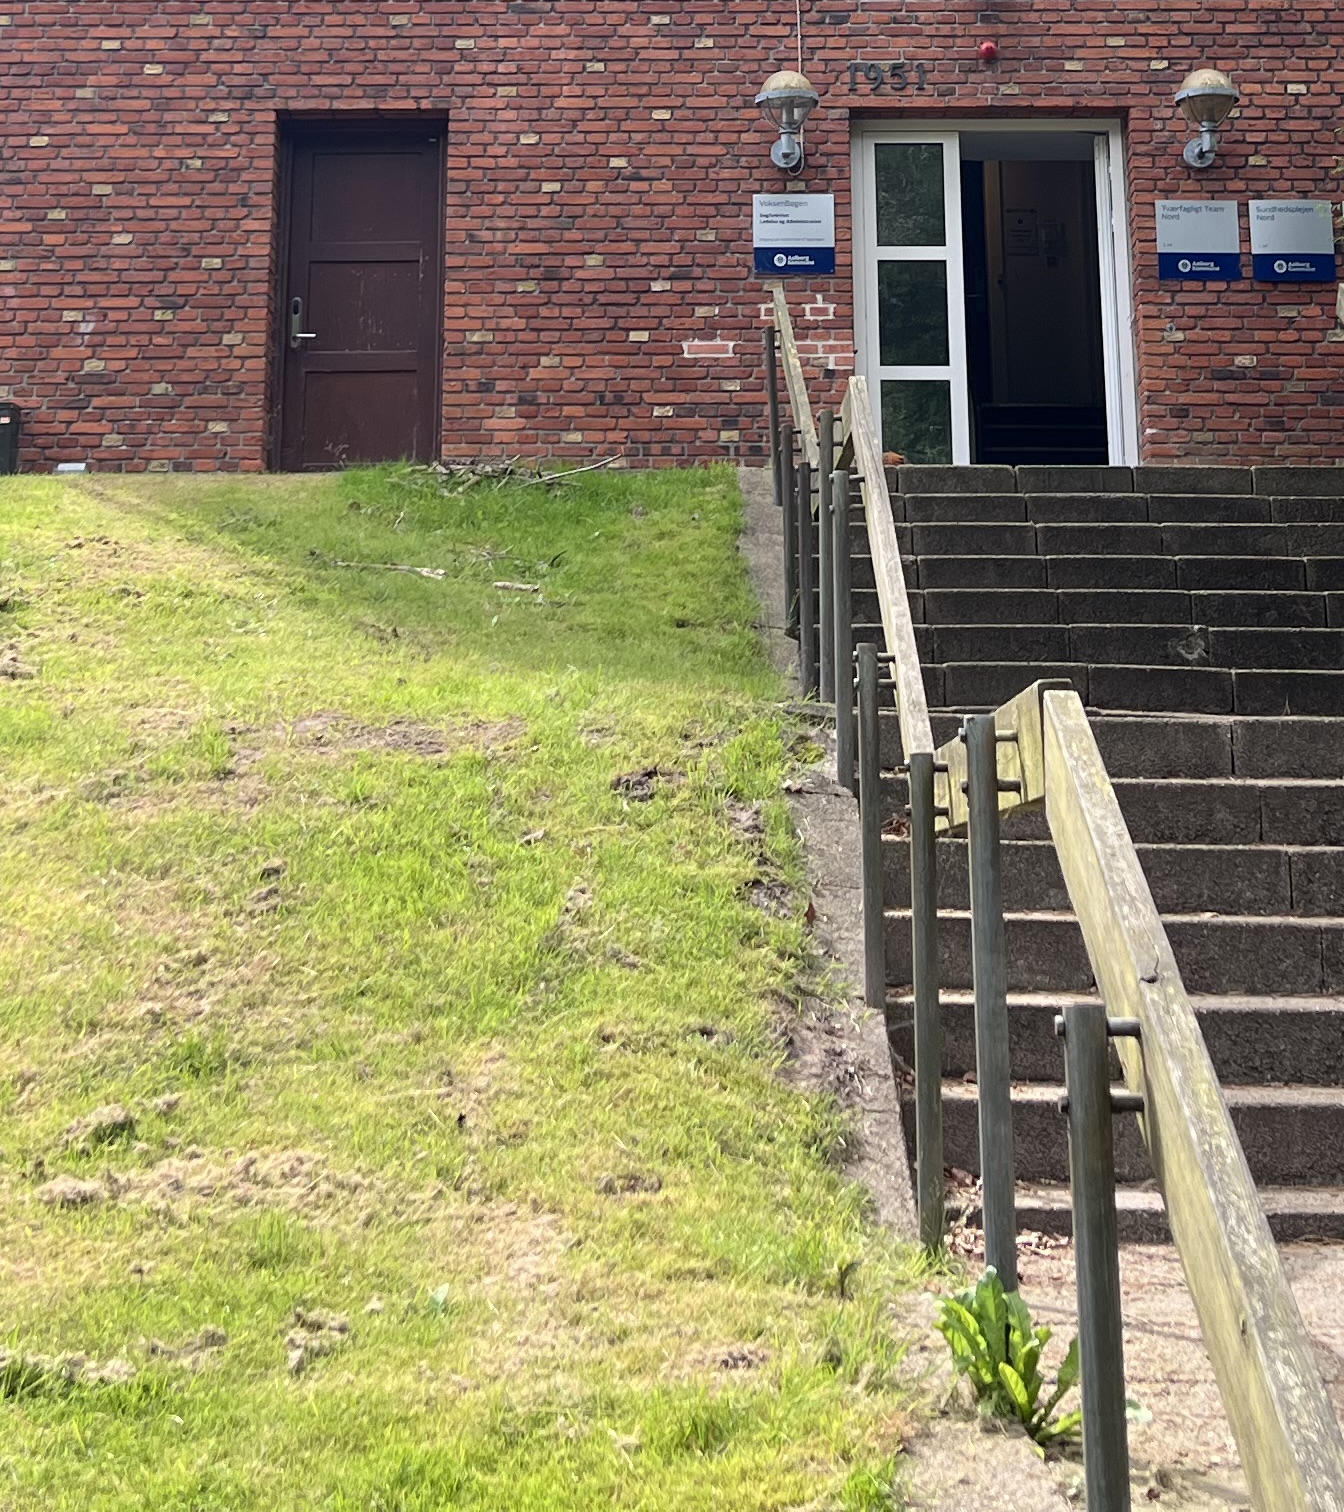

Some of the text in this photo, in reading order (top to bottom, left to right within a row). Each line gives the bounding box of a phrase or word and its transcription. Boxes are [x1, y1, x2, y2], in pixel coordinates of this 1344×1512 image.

[848, 61, 926, 91] 1951
[1204, 205, 1225, 213] Team
[1161, 213, 1180, 221] Nord
